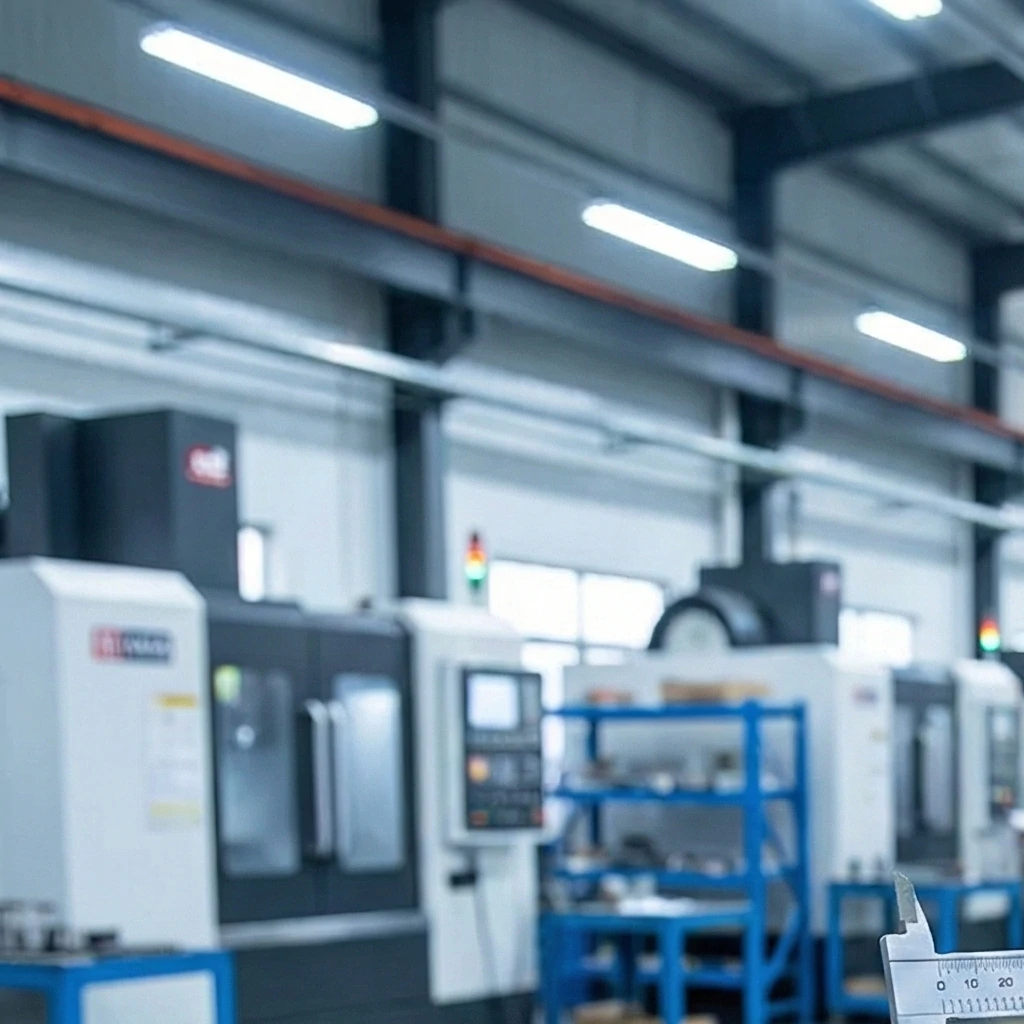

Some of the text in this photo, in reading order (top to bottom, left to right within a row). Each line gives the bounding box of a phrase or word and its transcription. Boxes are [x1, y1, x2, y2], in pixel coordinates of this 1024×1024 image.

[936, 980, 946, 991] 0
[964, 978, 979, 989] 10
[998, 977, 1013, 988] 20
